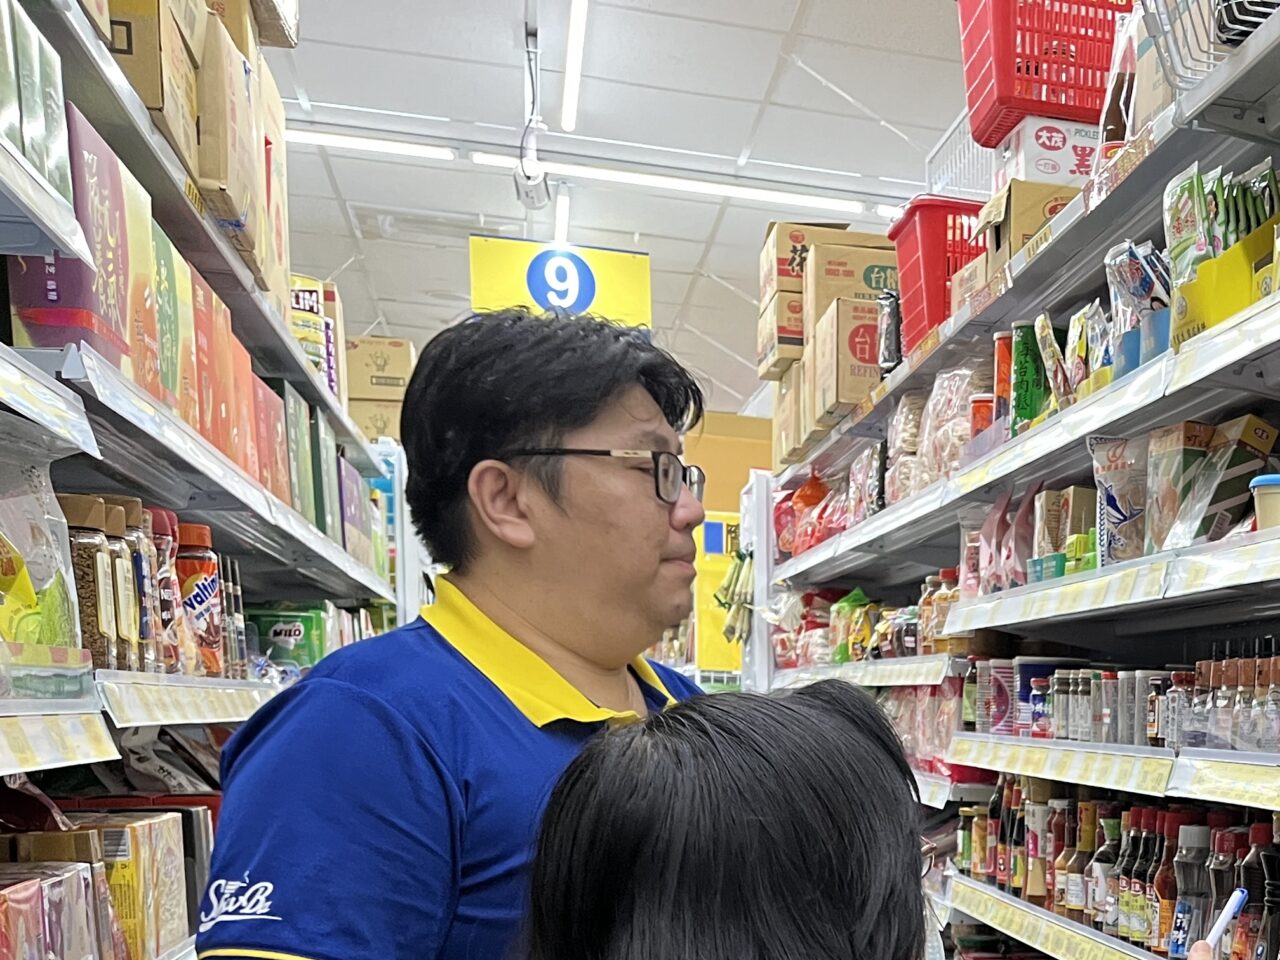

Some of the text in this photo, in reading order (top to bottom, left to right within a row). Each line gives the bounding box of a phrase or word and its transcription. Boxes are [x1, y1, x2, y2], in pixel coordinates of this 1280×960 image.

[1036, 130, 1066, 148] 大茂
[543, 256, 580, 309] 9
[183, 574, 218, 612] valtin
[272, 626, 302, 638] MILO
